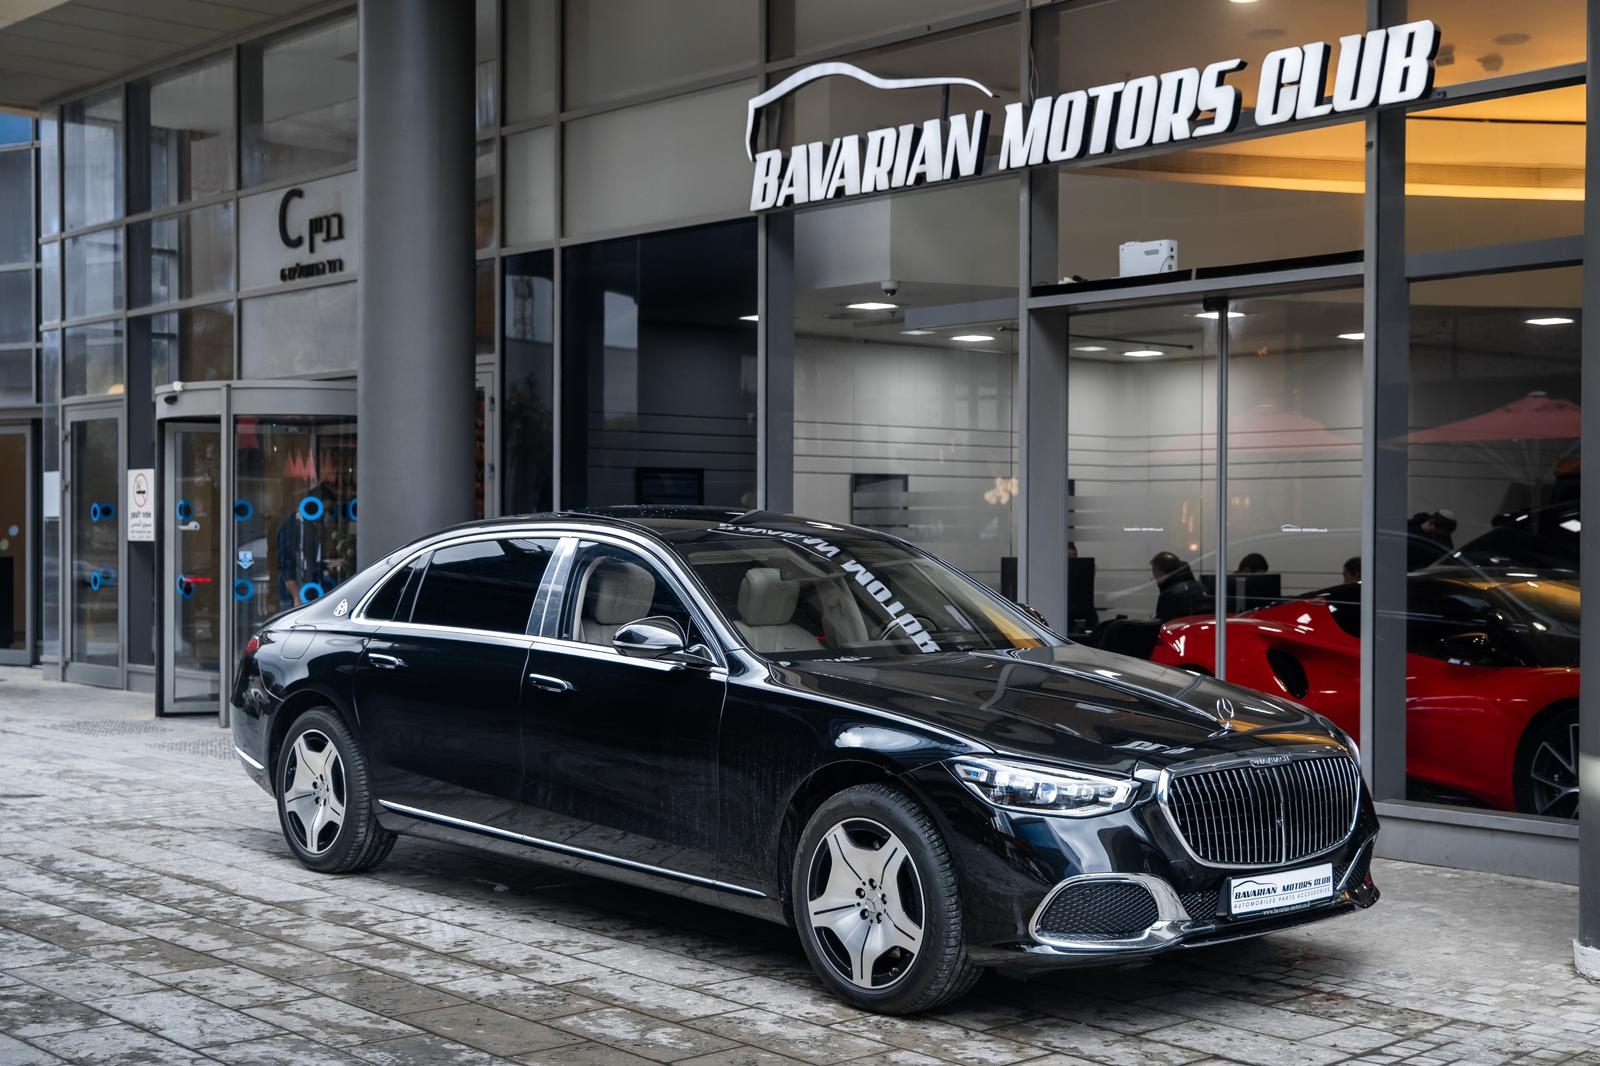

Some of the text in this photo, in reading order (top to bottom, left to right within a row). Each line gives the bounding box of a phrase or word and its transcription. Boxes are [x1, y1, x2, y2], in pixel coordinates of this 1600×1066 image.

[750, 20, 1441, 212] BAVARIAN MOTORS CLUB
[278, 188, 345, 254] בניין C
[1234, 899, 1275, 909] AUTOMOBILES
[1298, 887, 1330, 898] ACCESSORIES
[1235, 876, 1331, 900] BAVARIAN MOTORS CLUB
